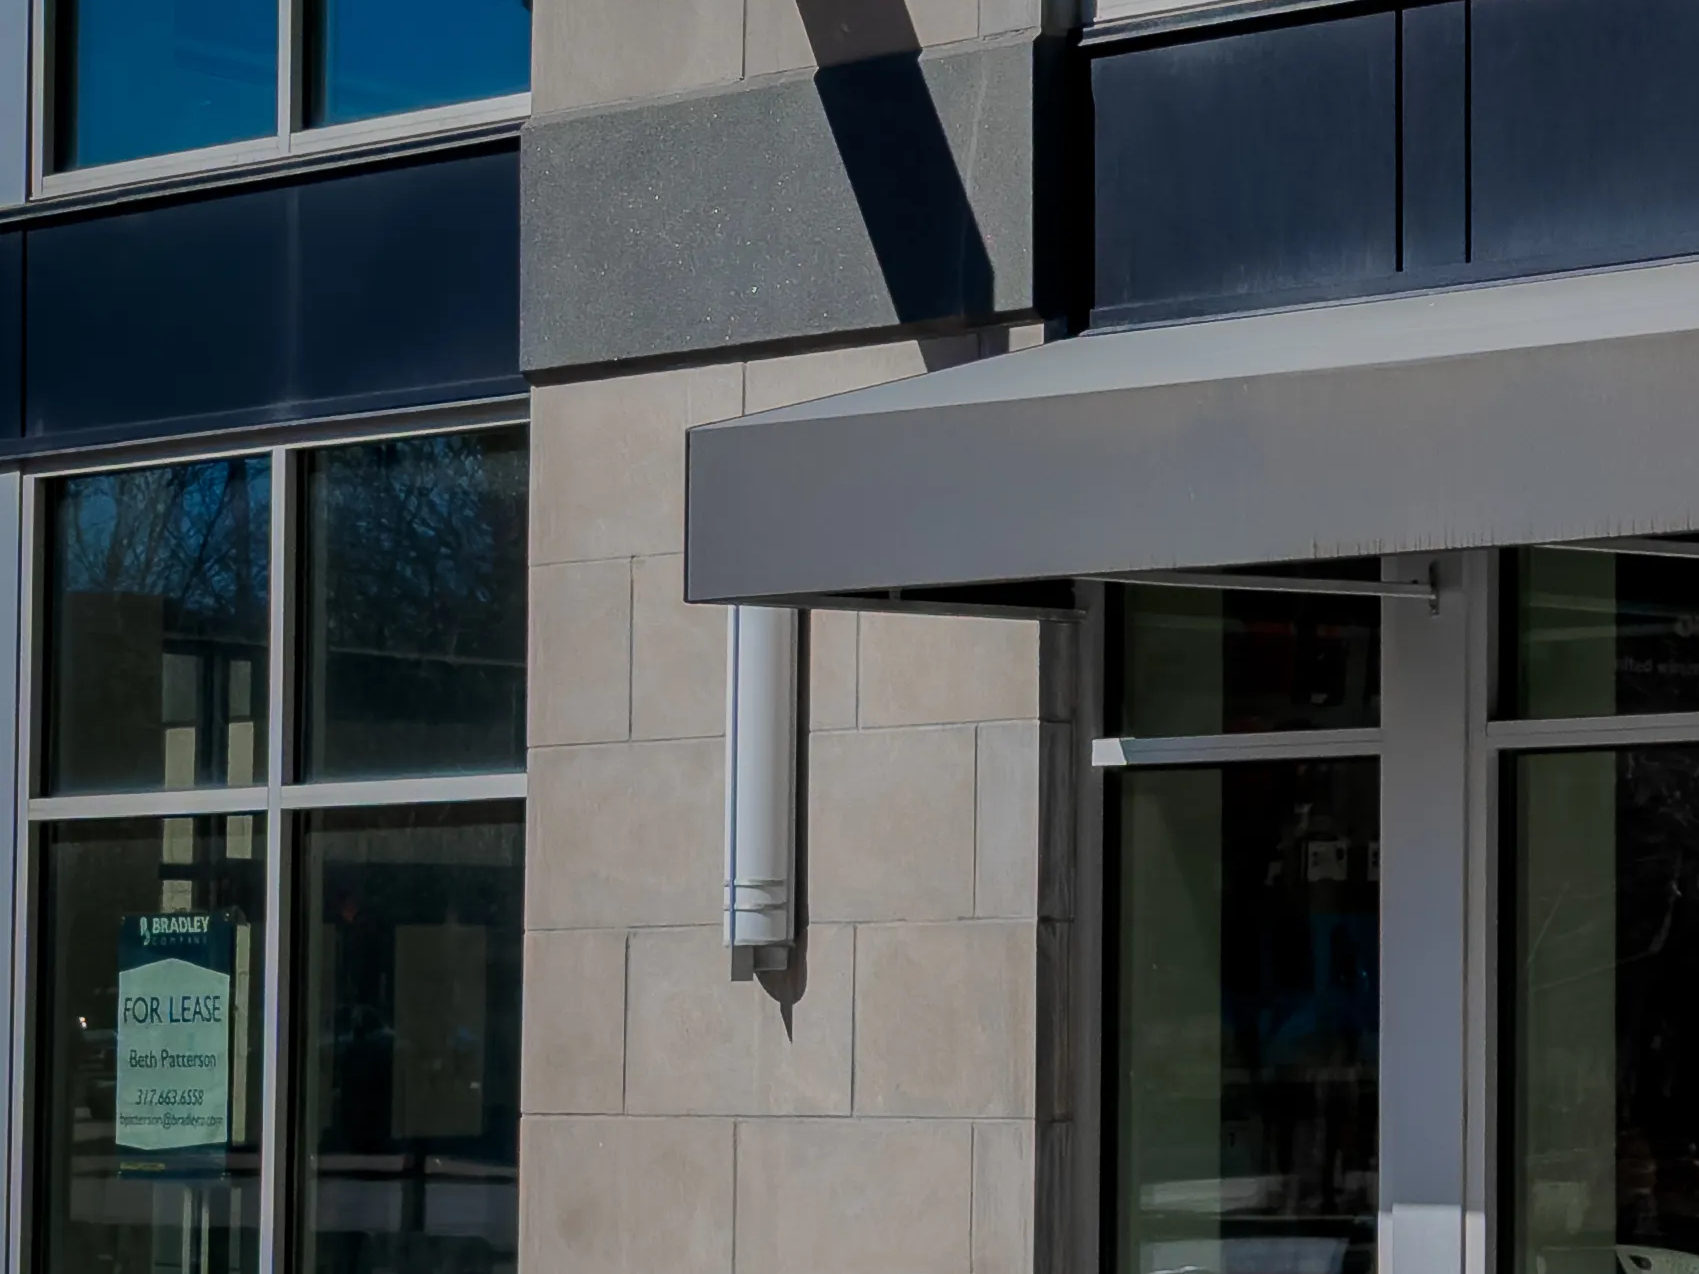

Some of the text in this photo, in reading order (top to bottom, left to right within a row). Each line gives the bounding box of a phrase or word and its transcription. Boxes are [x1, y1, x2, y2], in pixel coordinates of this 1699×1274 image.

[152, 915, 210, 934] BRADLEY
[123, 995, 222, 1024] FOR LEASE
[129, 1048, 217, 1068] Beth Patterson
